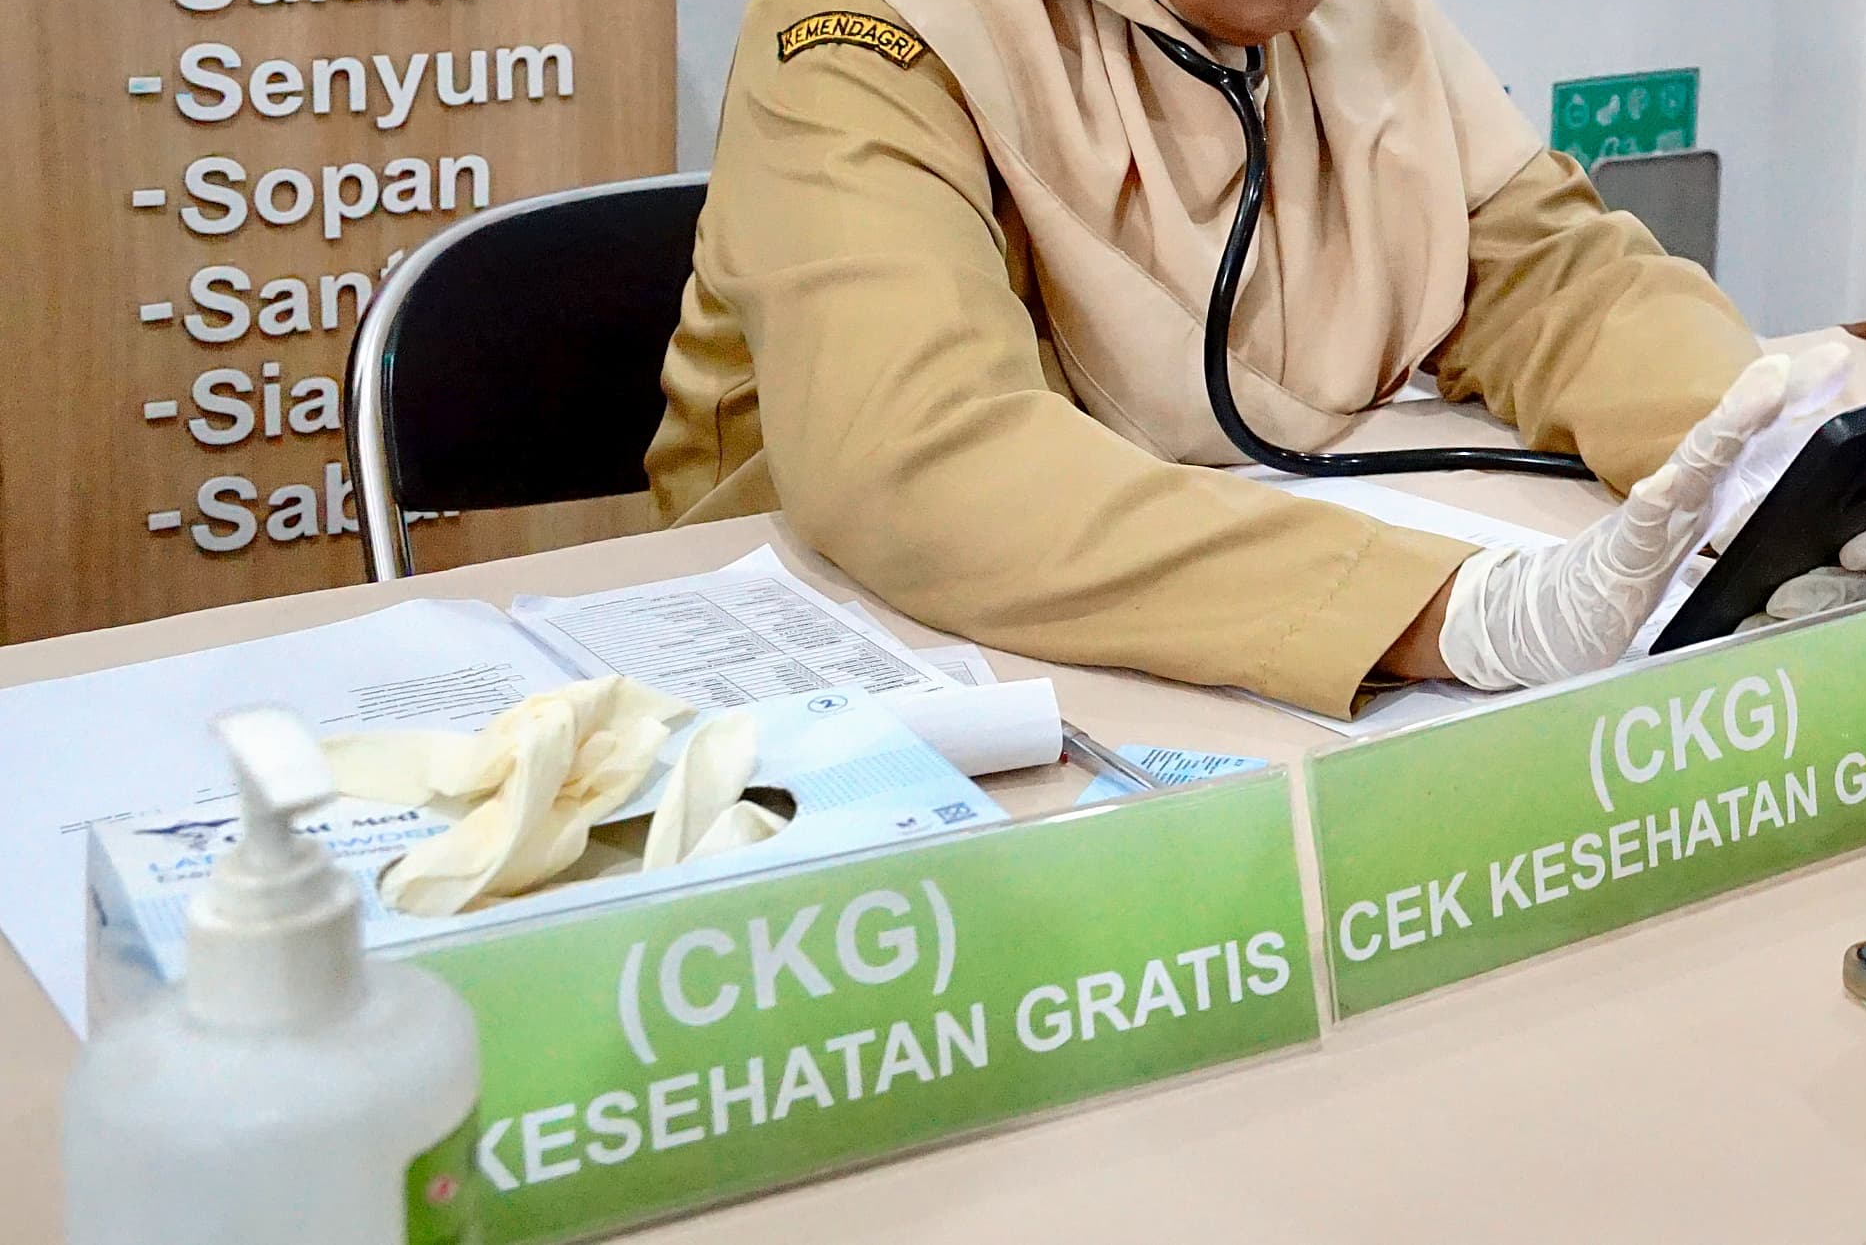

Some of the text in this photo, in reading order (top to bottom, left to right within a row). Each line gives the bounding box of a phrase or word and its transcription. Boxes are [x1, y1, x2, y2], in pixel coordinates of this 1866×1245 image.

[783, 17, 916, 60] KEMENDAGRI
[140, 249, 404, 344] -San
[144, 361, 341, 446] -Sia
[148, 461, 461, 553] -Sab
[1590, 667, 1799, 812] (CKG)
[1338, 870, 1472, 963] CEK
[1490, 765, 1819, 919] KESEHATAN
[616, 880, 958, 1064] (CKG)
[476, 931, 1291, 1192] KESEHATAN GRATIS
